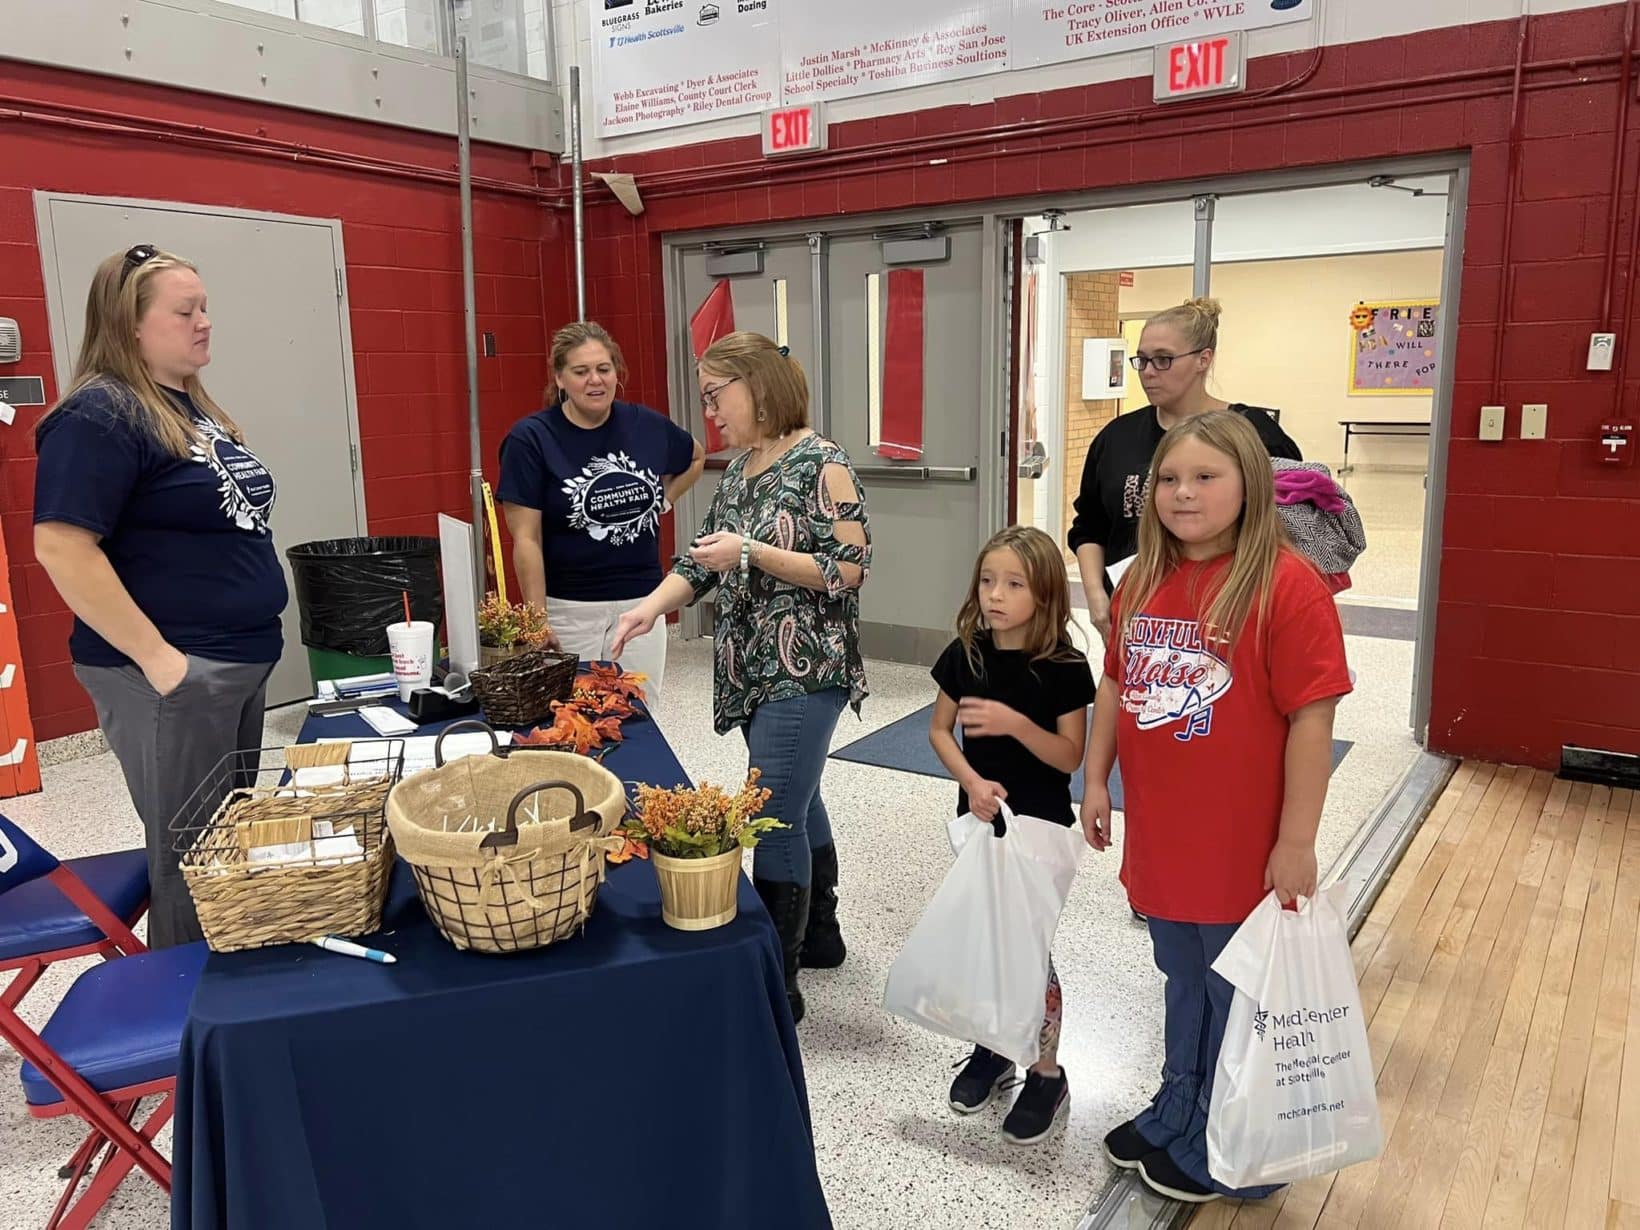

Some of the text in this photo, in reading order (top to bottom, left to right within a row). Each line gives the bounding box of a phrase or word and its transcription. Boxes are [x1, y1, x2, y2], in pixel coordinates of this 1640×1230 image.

[601, 11, 640, 27] BLUEGRASS
[645, 1, 684, 16] Bakeries
[737, 0, 767, 13] Dozing
[1042, 8, 1065, 21] The
[1067, 2, 1096, 17] Core
[1067, 17, 1101, 32] Tracy
[1104, 9, 1147, 24] Oliver,
[1150, 1, 1183, 15] Allen
[647, 24, 685, 40] Scottsville
[1065, 2, 1245, 46] UK Extension Office WVLE
[831, 47, 861, 62] Marsh
[869, 35, 920, 54] McKinney
[933, 23, 988, 41] Associates
[785, 68, 811, 83] Little
[812, 63, 845, 79] Dollies
[853, 52, 902, 71] Pharmacy
[903, 47, 926, 62] Arts
[958, 38, 979, 52] San
[980, 33, 1007, 49] Jose
[1168, 38, 1229, 92] EXIT
[613, 90, 634, 103] Webb
[636, 82, 680, 99] Excavating
[686, 77, 707, 91] Dyer
[716, 68, 760, 83] Associates
[784, 82, 815, 96] School
[816, 75, 860, 93] Specialty
[867, 65, 908, 81] Toshiba
[909, 58, 954, 74] Business
[602, 91, 772, 127] Jackson Photography Riley Dental Group
[615, 101, 640, 113] Elaine
[678, 89, 708, 103] County
[708, 85, 733, 97] Court
[733, 80, 758, 93] Clerk
[771, 107, 812, 149] EXIT
[1395, 341, 1423, 350] WILL
[1367, 361, 1409, 369] THERE
[590, 485, 646, 504] COMMUNITY
[590, 493, 649, 511] HEALTH FAIR
[1124, 651, 1209, 687] Noise
[1275, 1062, 1292, 1073] The
[1276, 1078, 1285, 1086] at
